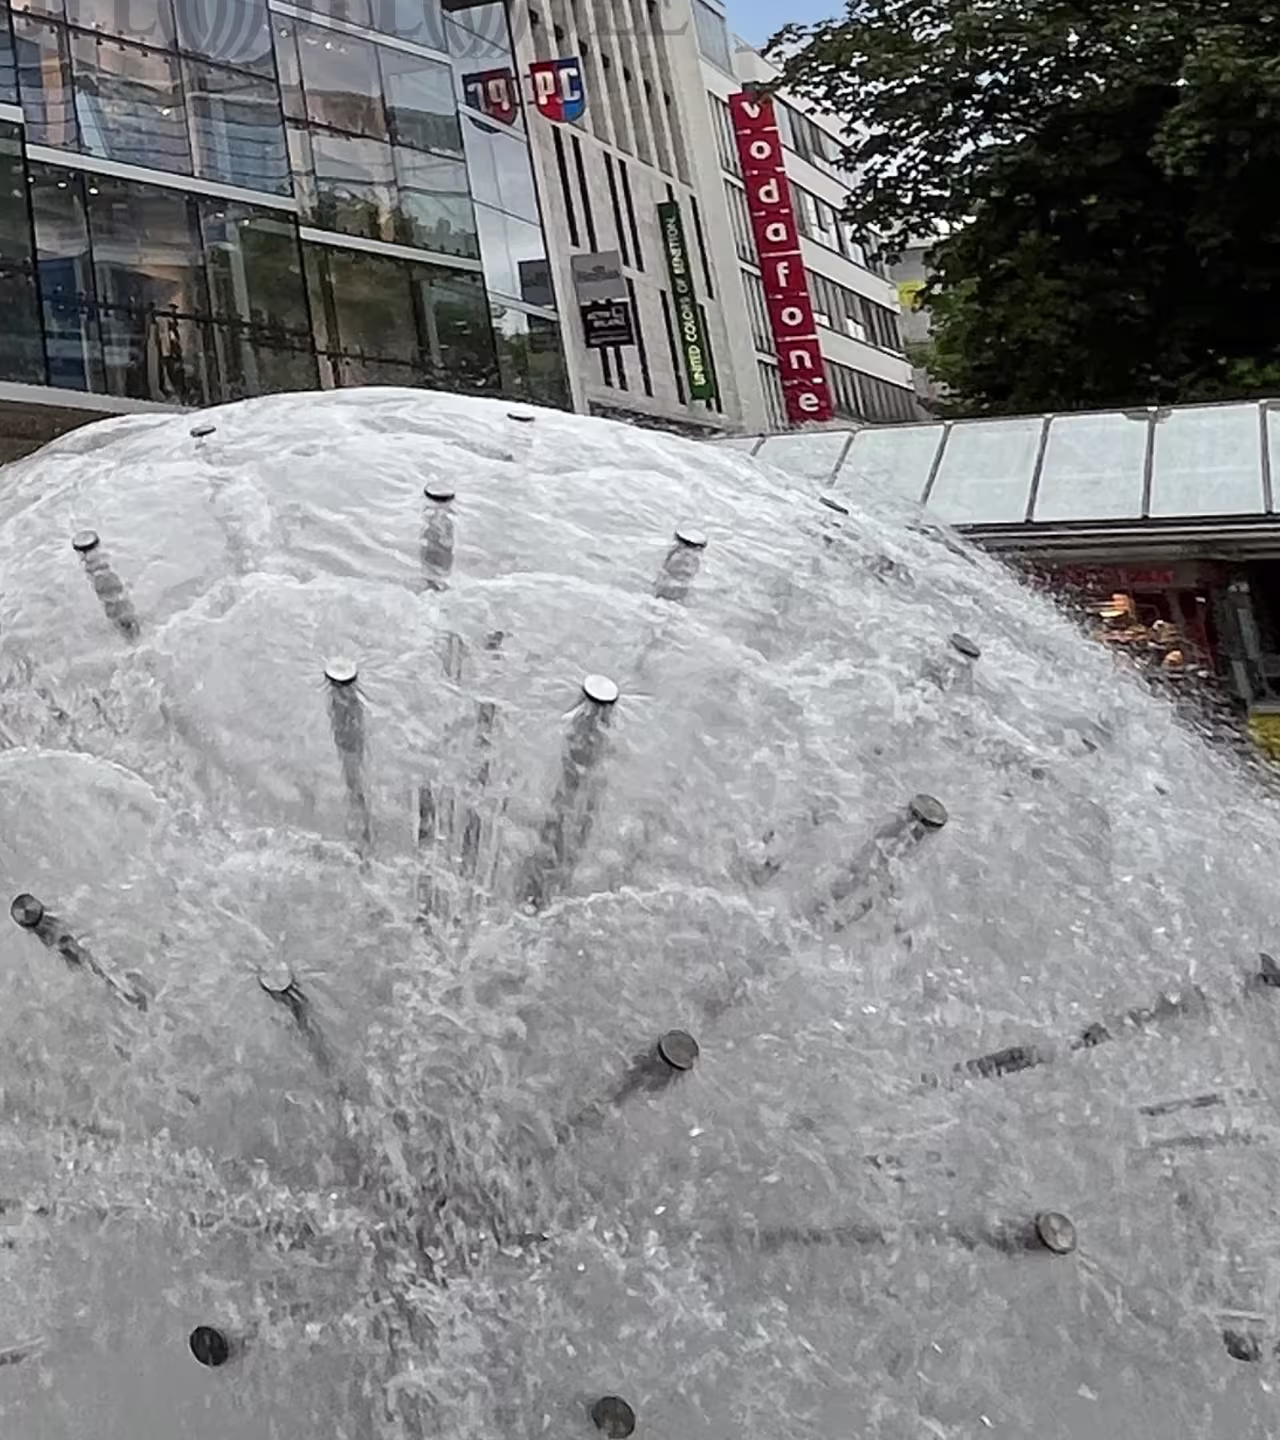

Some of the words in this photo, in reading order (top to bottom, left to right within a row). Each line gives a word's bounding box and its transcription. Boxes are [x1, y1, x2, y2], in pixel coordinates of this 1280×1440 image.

[666, 215, 686, 276] BENETTON
[741, 100, 821, 411] vodafone
[675, 277, 689, 294] OF
[679, 295, 698, 343] COLORS
[689, 345, 707, 387] UNITED
